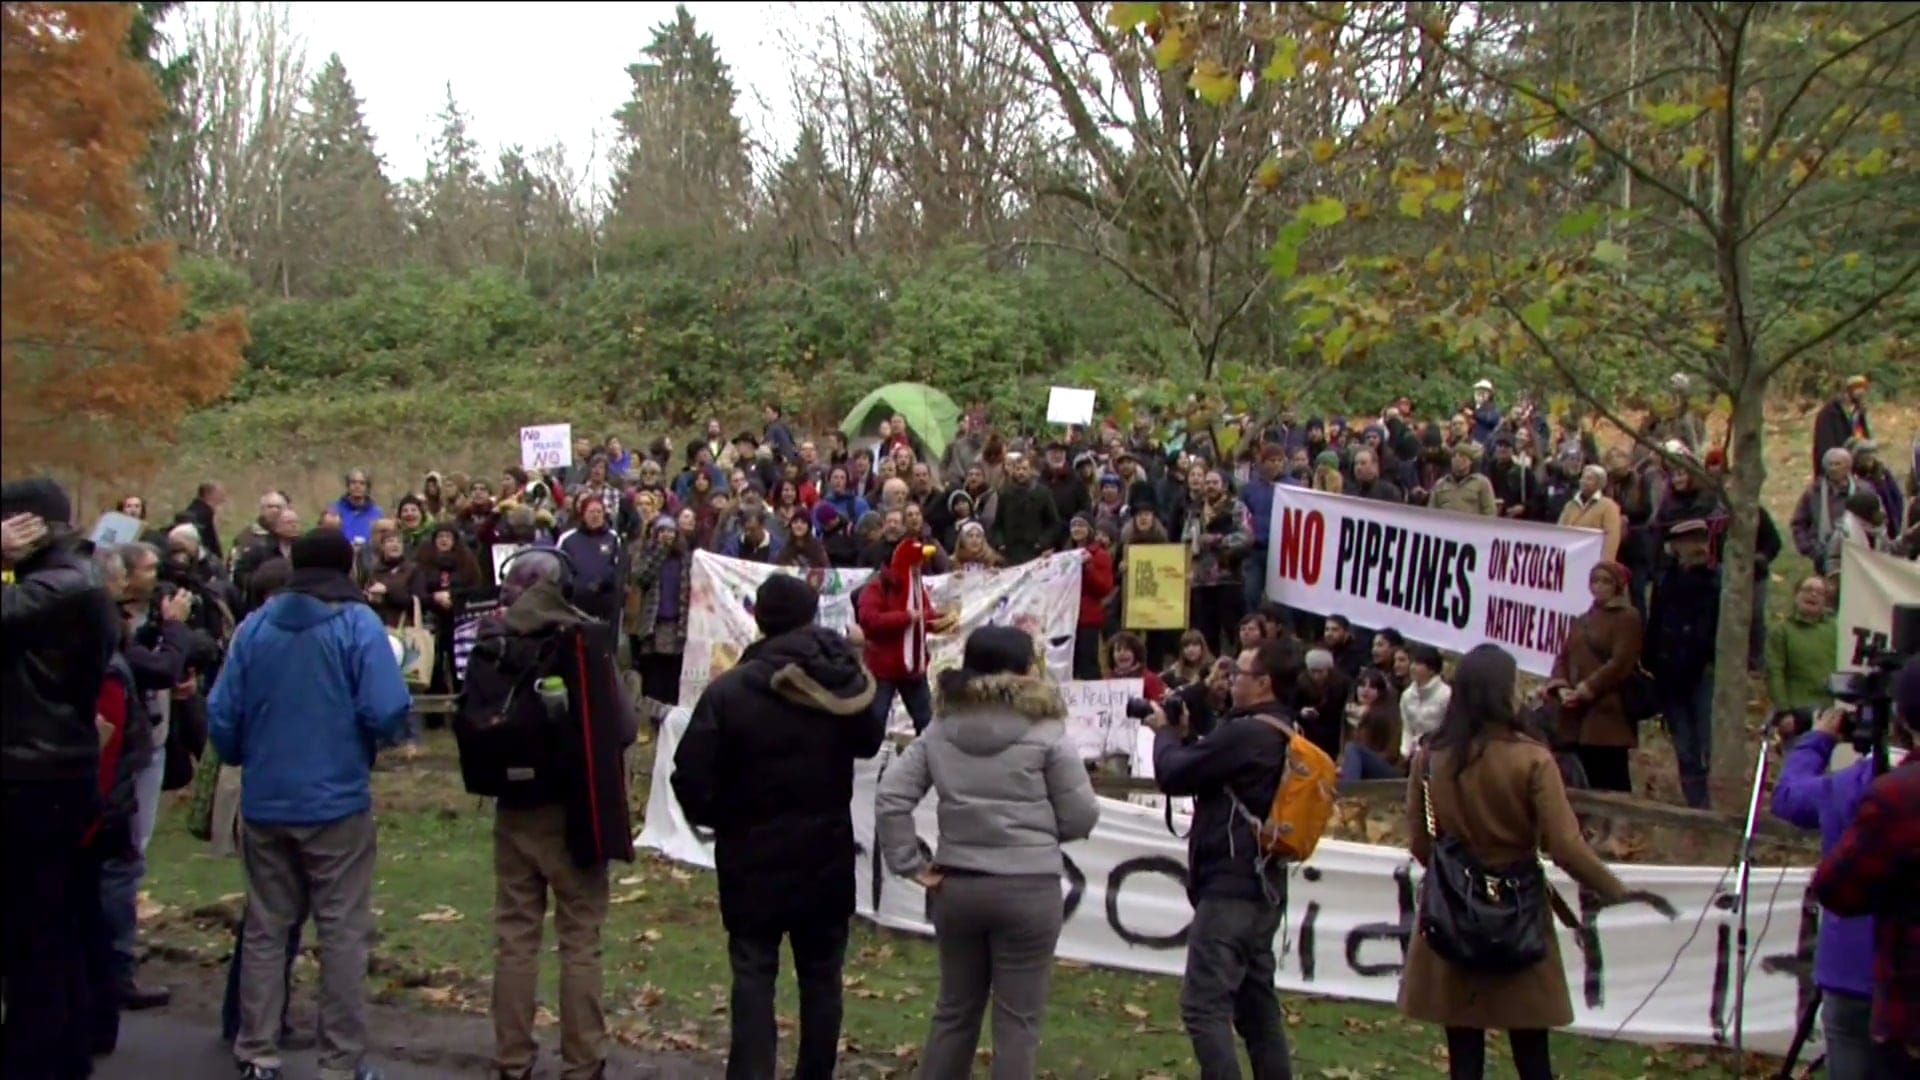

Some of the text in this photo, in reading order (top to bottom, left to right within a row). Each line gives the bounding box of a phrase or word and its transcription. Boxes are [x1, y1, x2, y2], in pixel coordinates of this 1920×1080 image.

[1280, 507, 1476, 629] NO PIPELINES
[1488, 538, 1566, 593] ON STOLEN
[1485, 594, 1536, 650] NATIVE
